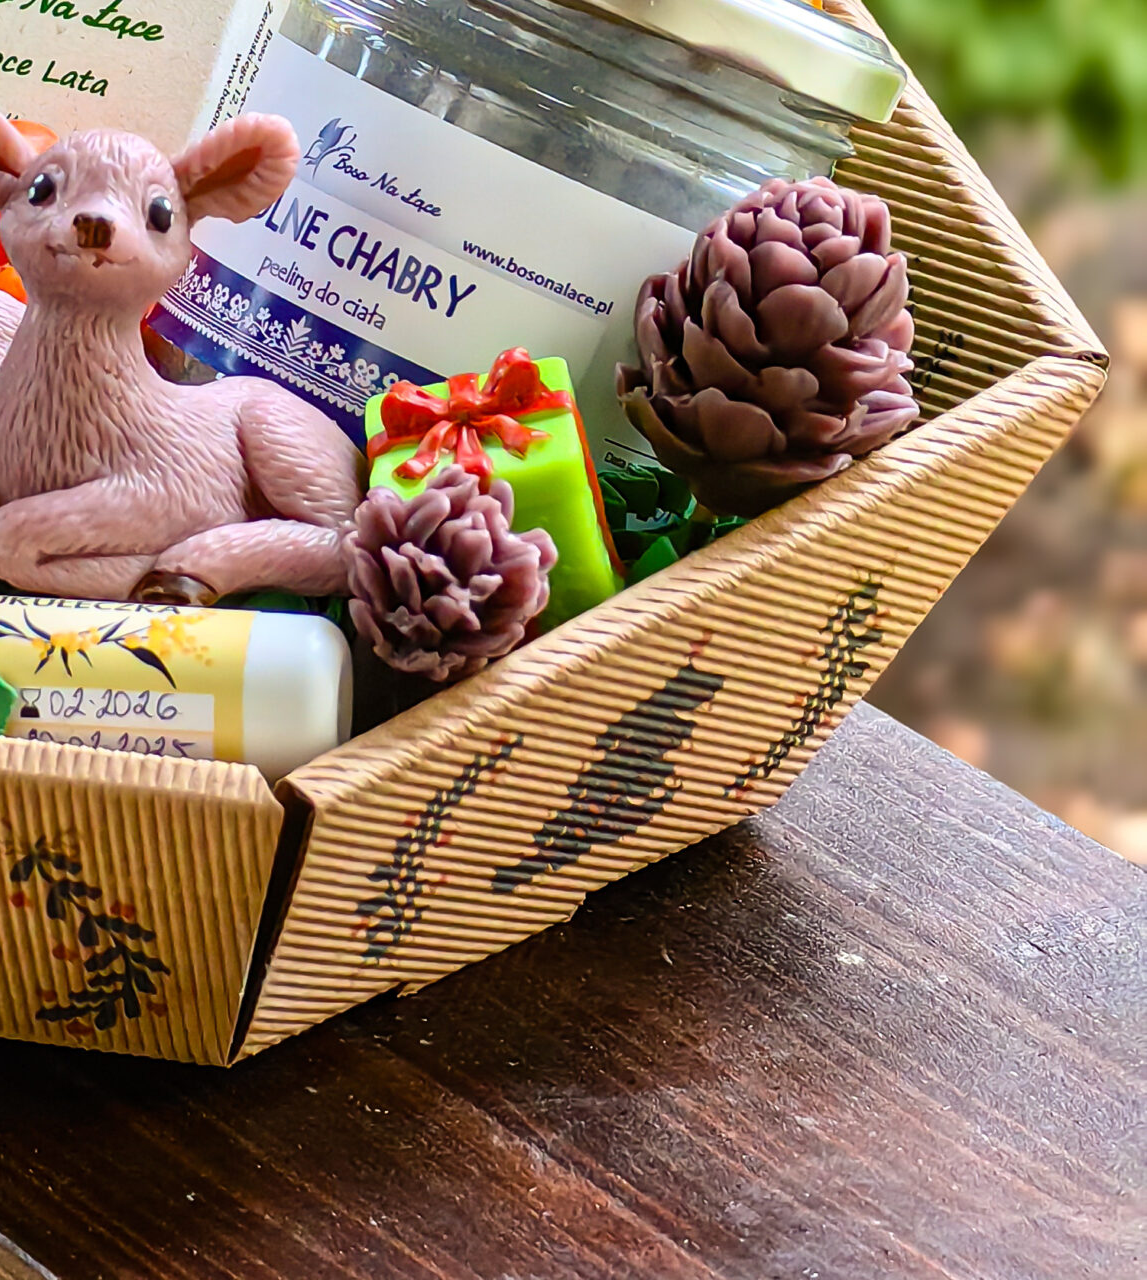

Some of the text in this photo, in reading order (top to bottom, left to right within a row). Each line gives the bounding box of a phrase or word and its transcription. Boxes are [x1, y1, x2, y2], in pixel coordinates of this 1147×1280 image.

[41, 60, 109, 97] Lata
[333, 153, 369, 181] Boso
[370, 172, 399, 197] Na
[256, 255, 386, 331] peeling do ciała
[327, 225, 477, 318] CHABRY
[462, 240, 614, 315] www.bosonalace.pl
